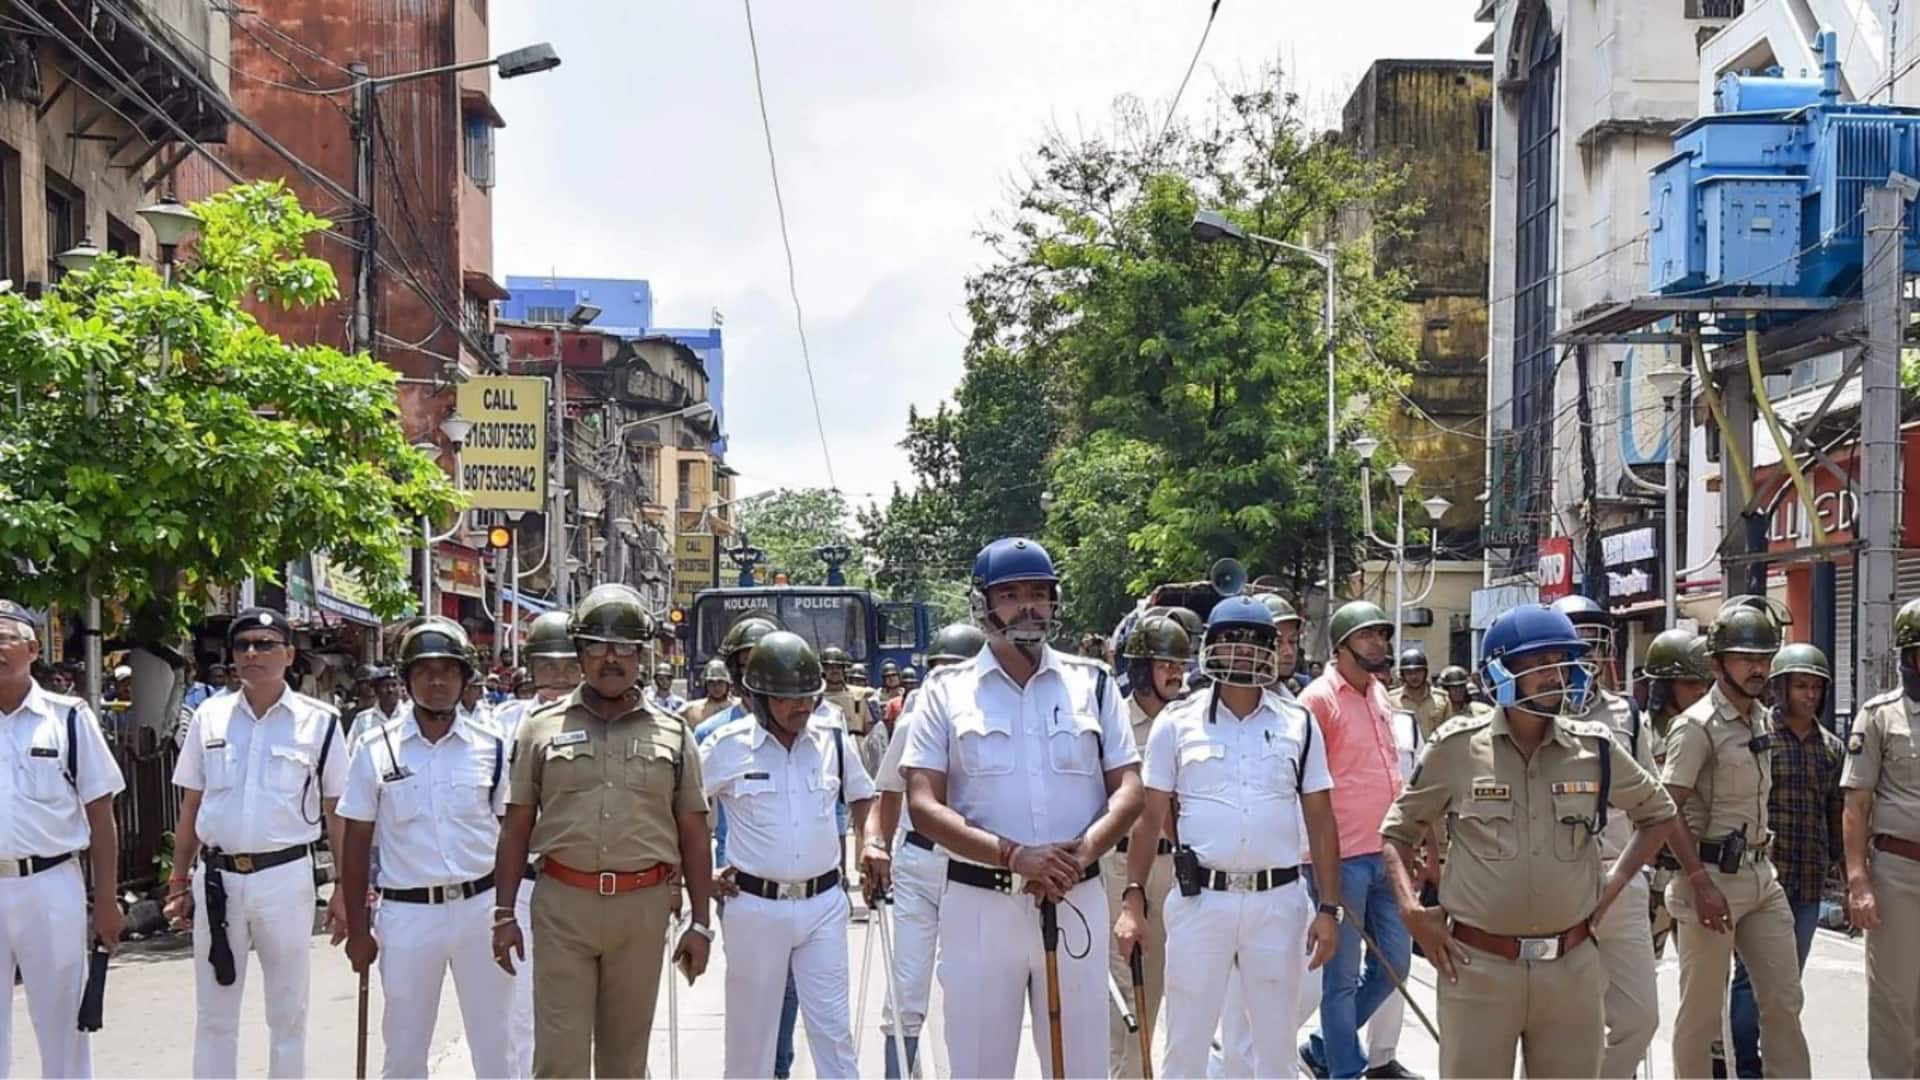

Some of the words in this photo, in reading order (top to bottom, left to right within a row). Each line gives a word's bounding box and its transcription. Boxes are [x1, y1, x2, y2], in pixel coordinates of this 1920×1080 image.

[483, 388, 518, 410] CALL
[463, 464, 536, 492] 9875395942
[724, 598, 768, 609] KOLKATA
[795, 597, 840, 609] POLICE
